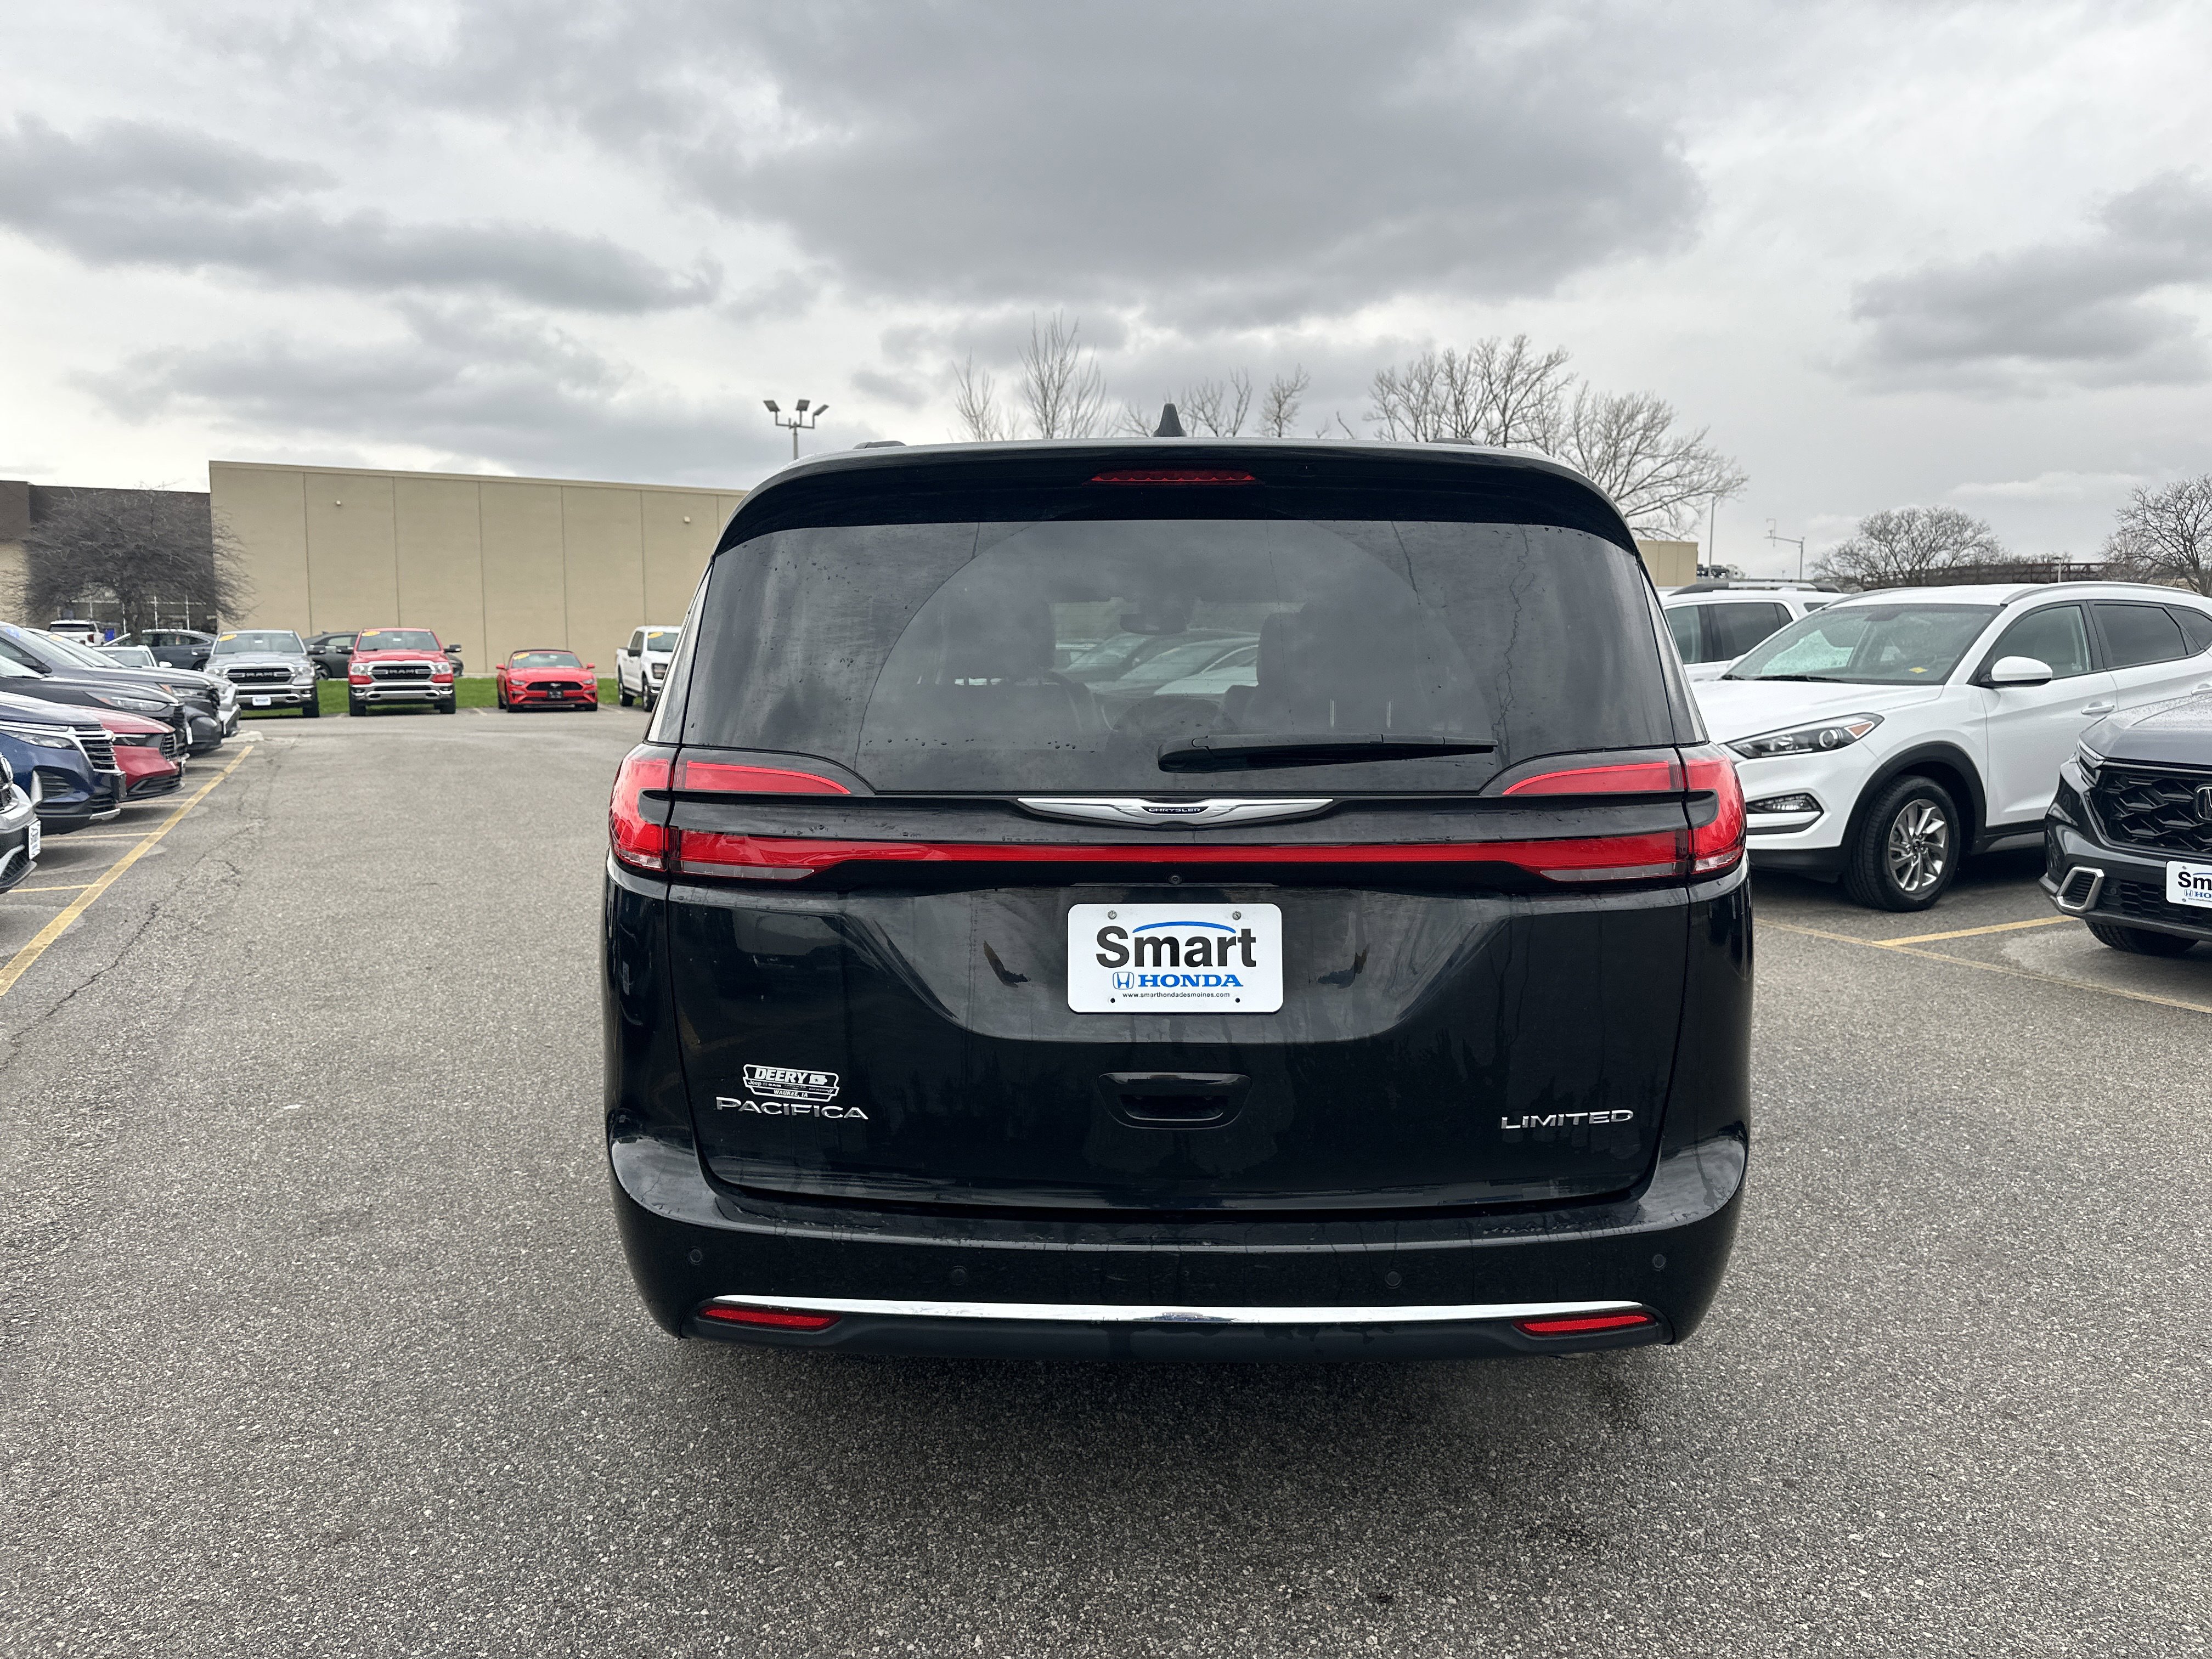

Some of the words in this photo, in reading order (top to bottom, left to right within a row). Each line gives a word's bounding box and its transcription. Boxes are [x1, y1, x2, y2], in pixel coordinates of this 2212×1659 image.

[1096, 925, 1256, 968] Smart
[1138, 974, 1243, 987] HONDA
[754, 1068, 809, 1084] DEERY
[716, 1097, 868, 1120] PACIFICA
[1501, 1109, 1634, 1129] LIMITED
